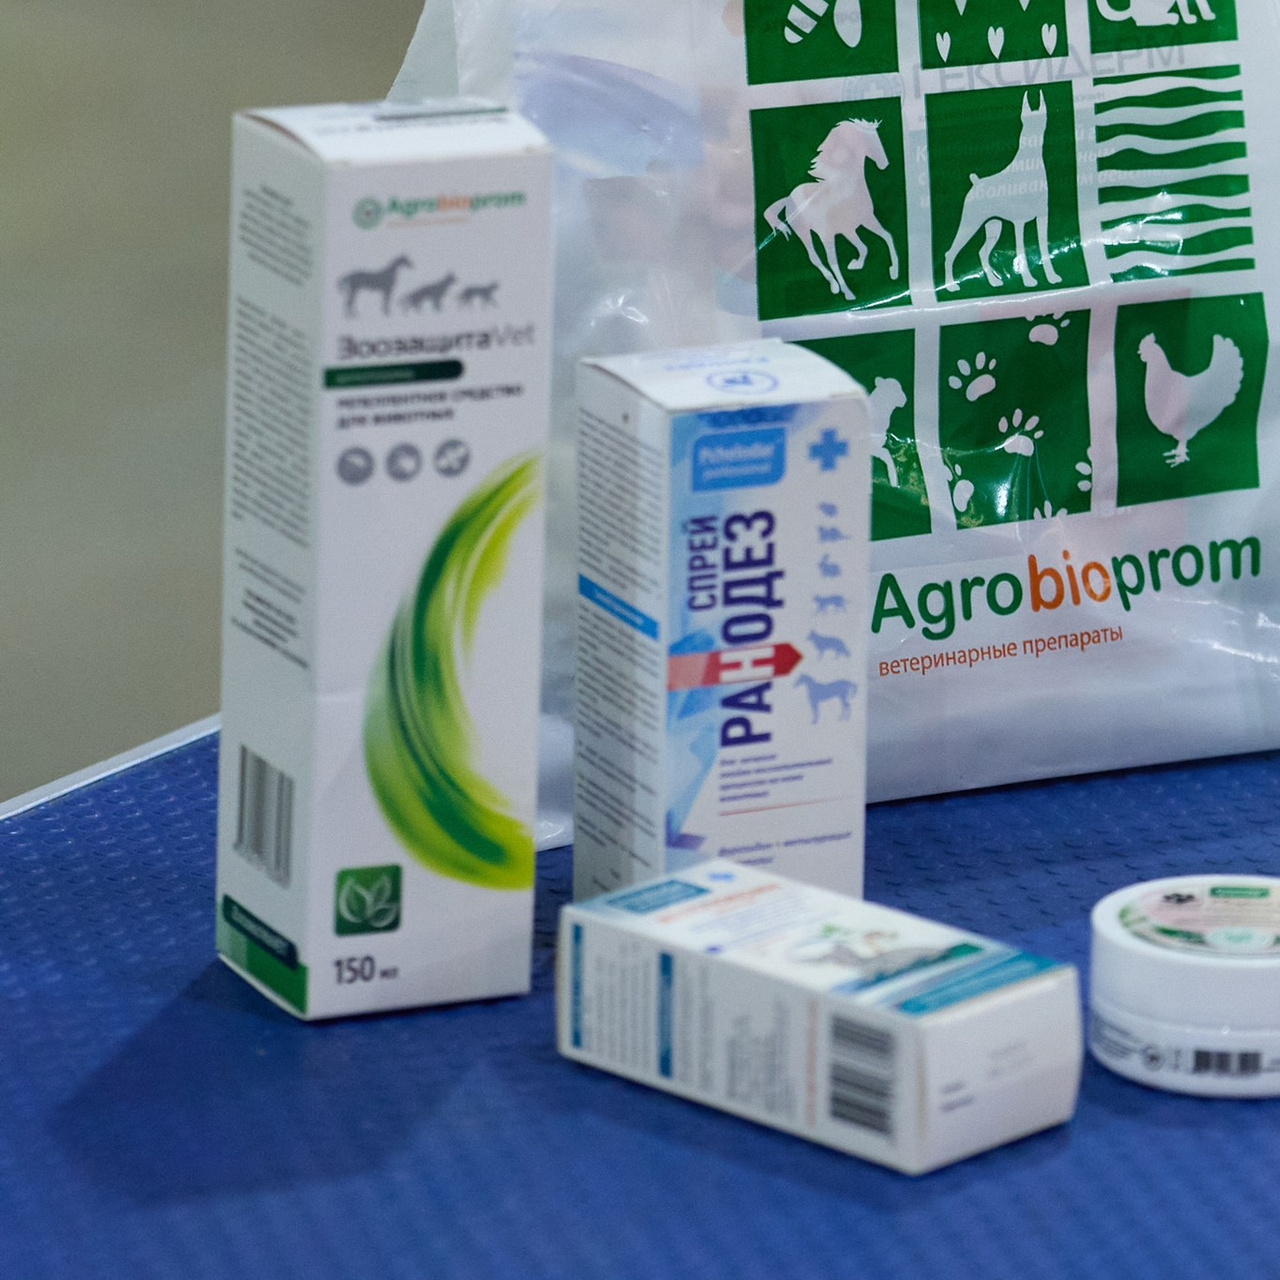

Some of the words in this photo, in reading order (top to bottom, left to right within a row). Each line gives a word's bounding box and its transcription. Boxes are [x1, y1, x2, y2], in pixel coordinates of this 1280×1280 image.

[682, 515, 718, 612] СПРЕЙ
[871, 535, 1262, 641] Agrobioprom
[720, 509, 786, 749] РАНОДЕЗ
[877, 641, 1018, 677] ветеринарные
[1022, 624, 1123, 659] препараты
[333, 955, 376, 985] 150
